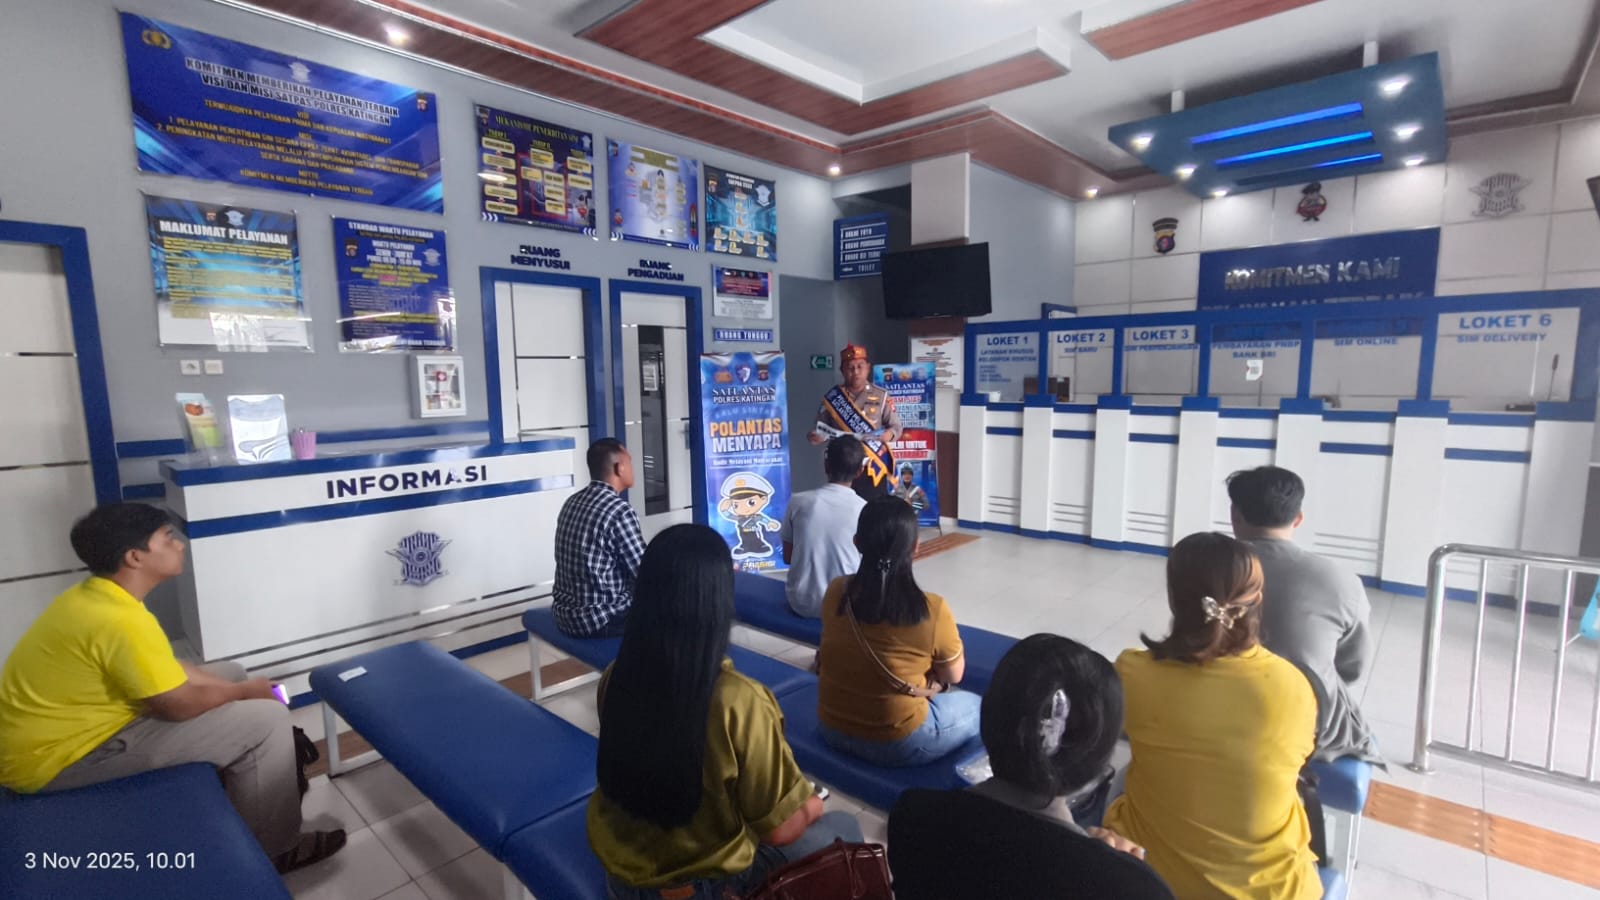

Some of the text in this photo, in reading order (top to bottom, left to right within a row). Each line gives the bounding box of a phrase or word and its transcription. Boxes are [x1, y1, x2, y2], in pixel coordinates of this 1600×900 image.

[185, 57, 399, 118] KOMITMEN MEMBERIKAN PELAYANAN TERBAIK
[201, 73, 391, 126] VISI DAN MISI SATPAS POLRES KATINGAN
[159, 220, 288, 245] MAKLUMAT PELAYANAN
[348, 221, 378, 232] STANDAR
[520, 245, 561, 259] RUANG
[511, 254, 571, 271] MENYUSUI
[639, 260, 672, 271] RUANG
[627, 268, 684, 282] PENGADUAN
[1225, 256, 1401, 291] KOMITMEN KAMI
[1458, 313, 1552, 330] LOKET 6
[986, 335, 1028, 346] LOKET 1
[1057, 332, 1106, 344] LOKET 2
[1132, 329, 1189, 341] LOKET 3
[1333, 336, 1397, 347] SIM ONLINE
[1456, 332, 1548, 344] SIM DELIVERY
[1232, 350, 1277, 359] BANK BRI
[712, 385, 777, 397] SATLANTAS
[713, 393, 776, 404] POLRES KATINGAN
[709, 417, 783, 438] POLANTAS
[712, 434, 782, 454] MENYAPA
[326, 464, 488, 499] INFORMASI
